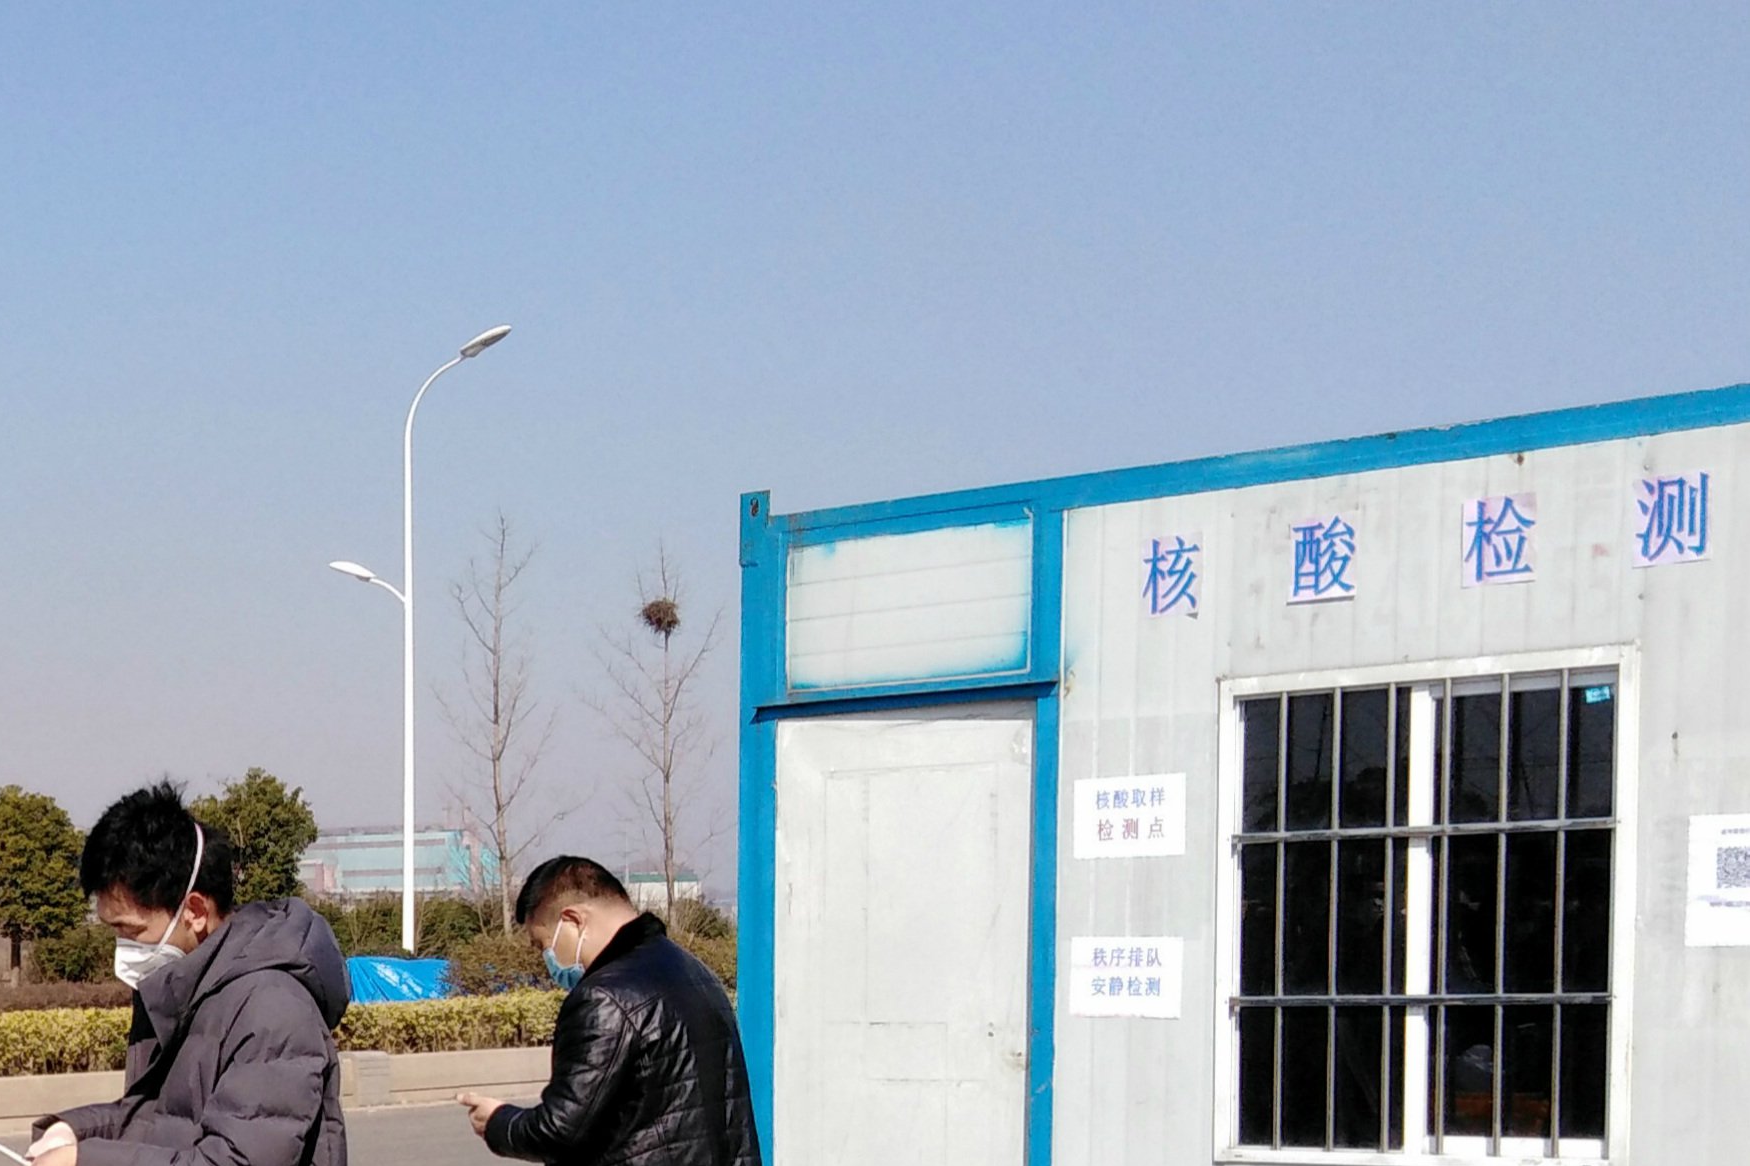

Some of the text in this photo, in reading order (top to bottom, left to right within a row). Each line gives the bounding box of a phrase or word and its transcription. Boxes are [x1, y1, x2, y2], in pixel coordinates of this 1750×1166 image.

[1142, 472, 1709, 616] 核酸检测
[1096, 787, 1166, 810] 核酸取样
[1097, 816, 1165, 841] 检测点
[1091, 947, 1162, 967] 秩序排队
[1091, 976, 1161, 996] 安静检测
